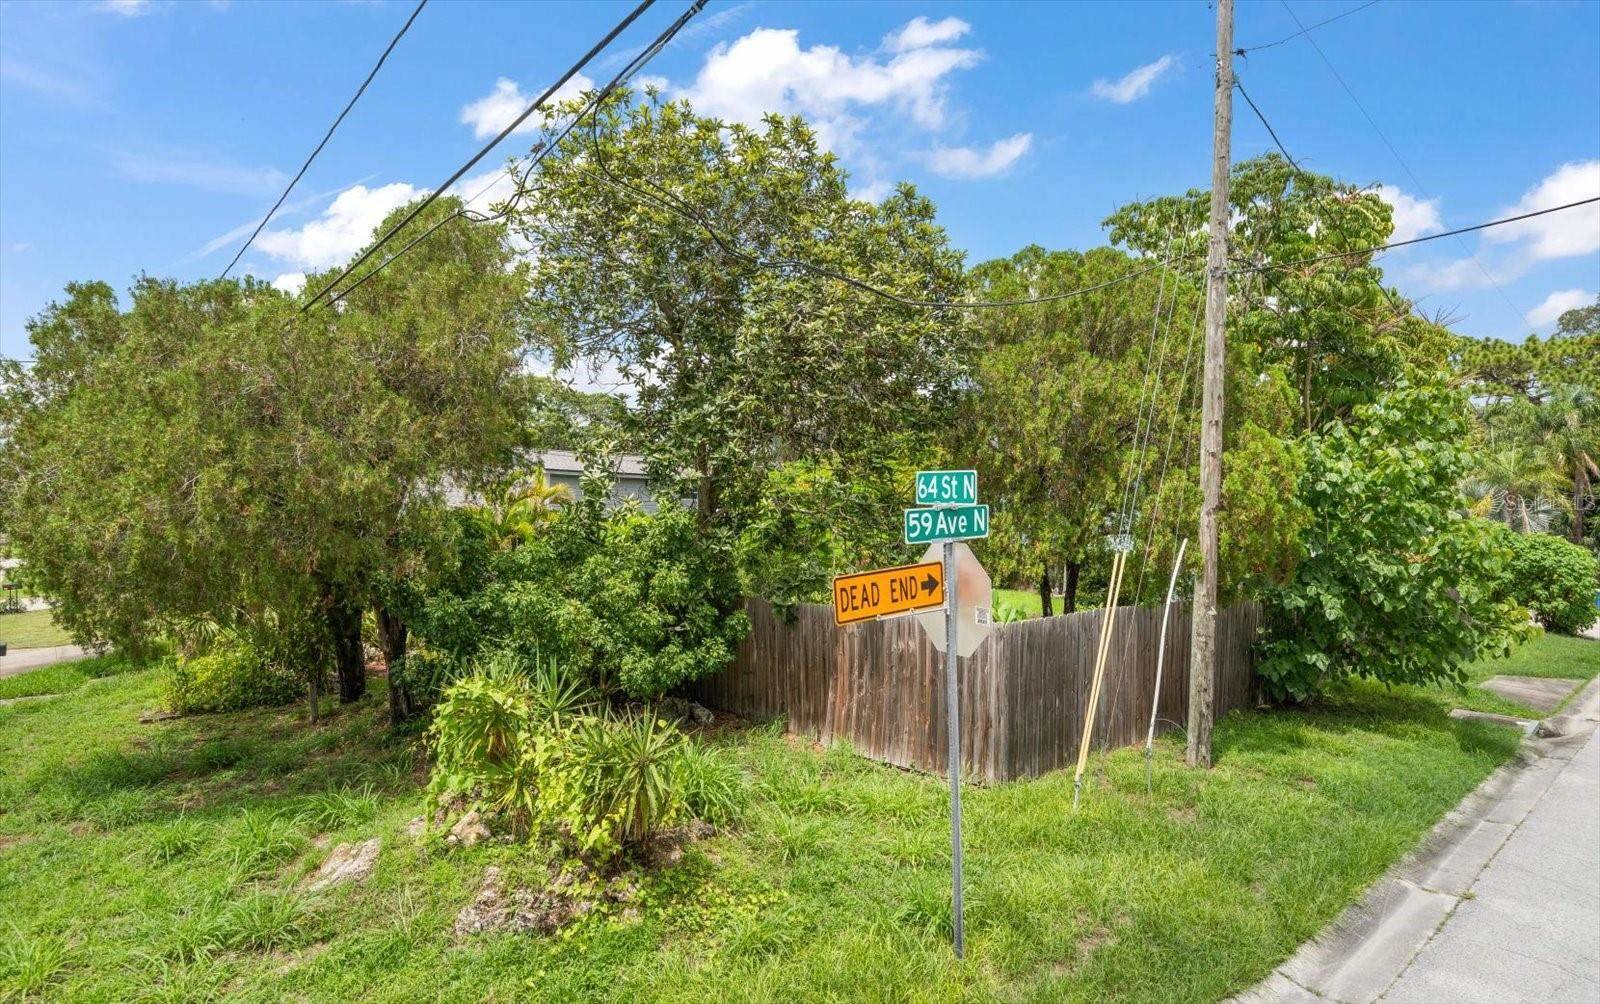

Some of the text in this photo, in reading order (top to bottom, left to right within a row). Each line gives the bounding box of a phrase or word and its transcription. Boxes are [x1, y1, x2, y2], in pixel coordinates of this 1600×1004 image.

[918, 474, 975, 499] 64 St N
[909, 509, 985, 538] 59 Ave N
[839, 575, 918, 613] DEAD END
